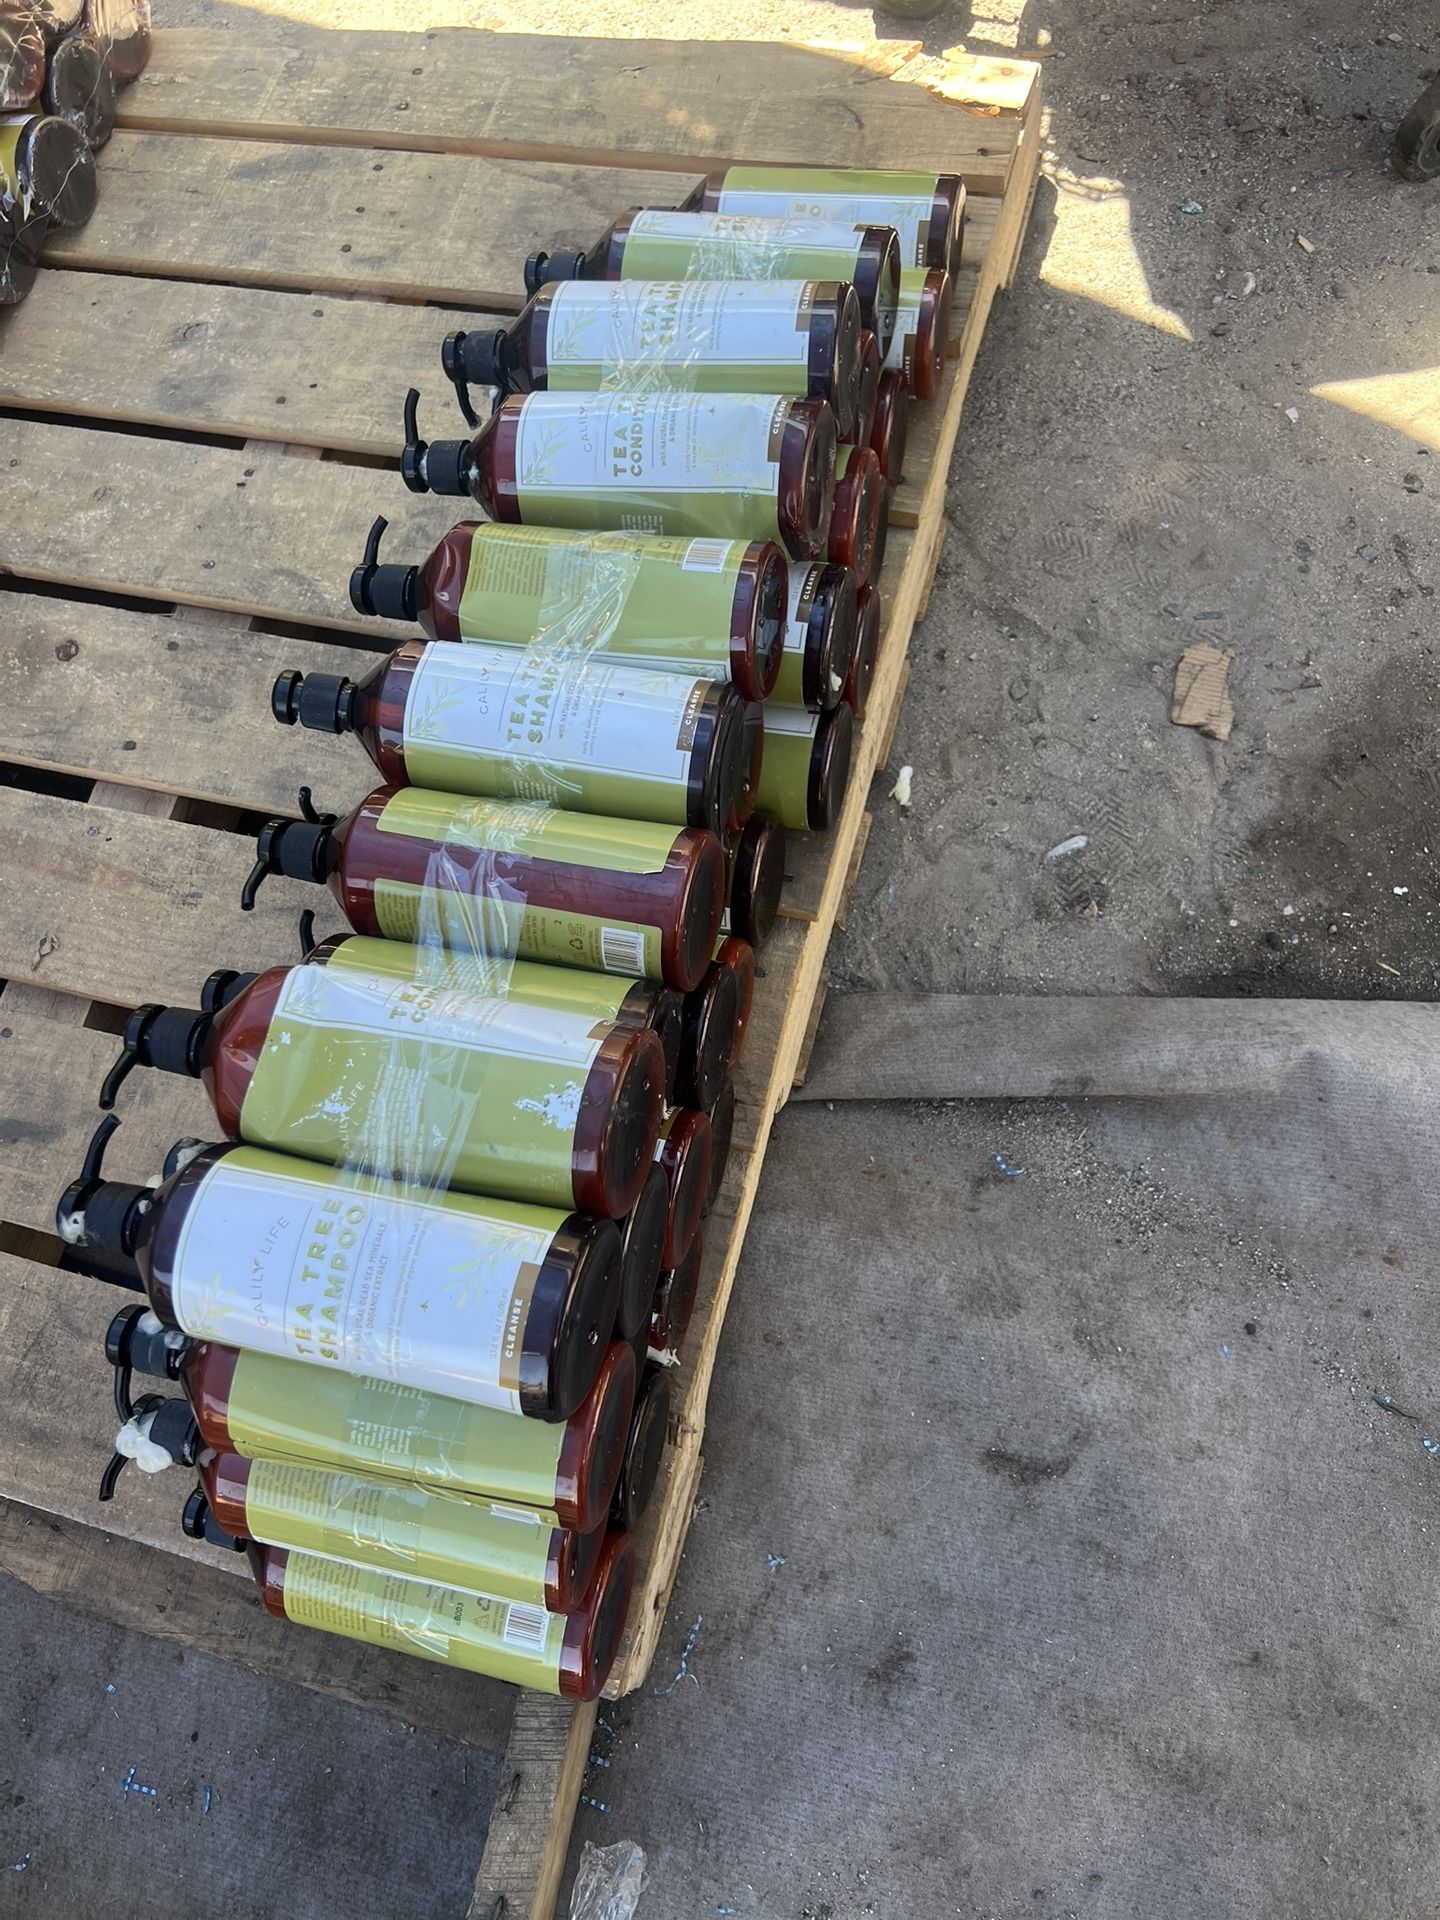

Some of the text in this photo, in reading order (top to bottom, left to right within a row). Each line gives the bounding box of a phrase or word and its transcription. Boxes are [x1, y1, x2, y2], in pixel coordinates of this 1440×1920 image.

[640, 304, 658, 349] TEA
[579, 406, 592, 453] CALILY
[613, 426, 628, 477] TEA
[479, 668, 490, 715] CALILY
[685, 690, 701, 725] CLEANSE
[507, 694, 530, 742] TEA
[368, 1222, 388, 1267] MINERALS
[251, 1216, 290, 1326] CALILY LIFE
[294, 1199, 343, 1354] TEA TREE
[319, 1205, 366, 1360] SHAMPOO
[359, 1283, 370, 1306] DEAD
[367, 1265, 375, 1283] SEA
[367, 1293, 380, 1330] ORGANIC
[374, 1255, 389, 1292] EXTRACT
[505, 1299, 523, 1358] CLEANSE
